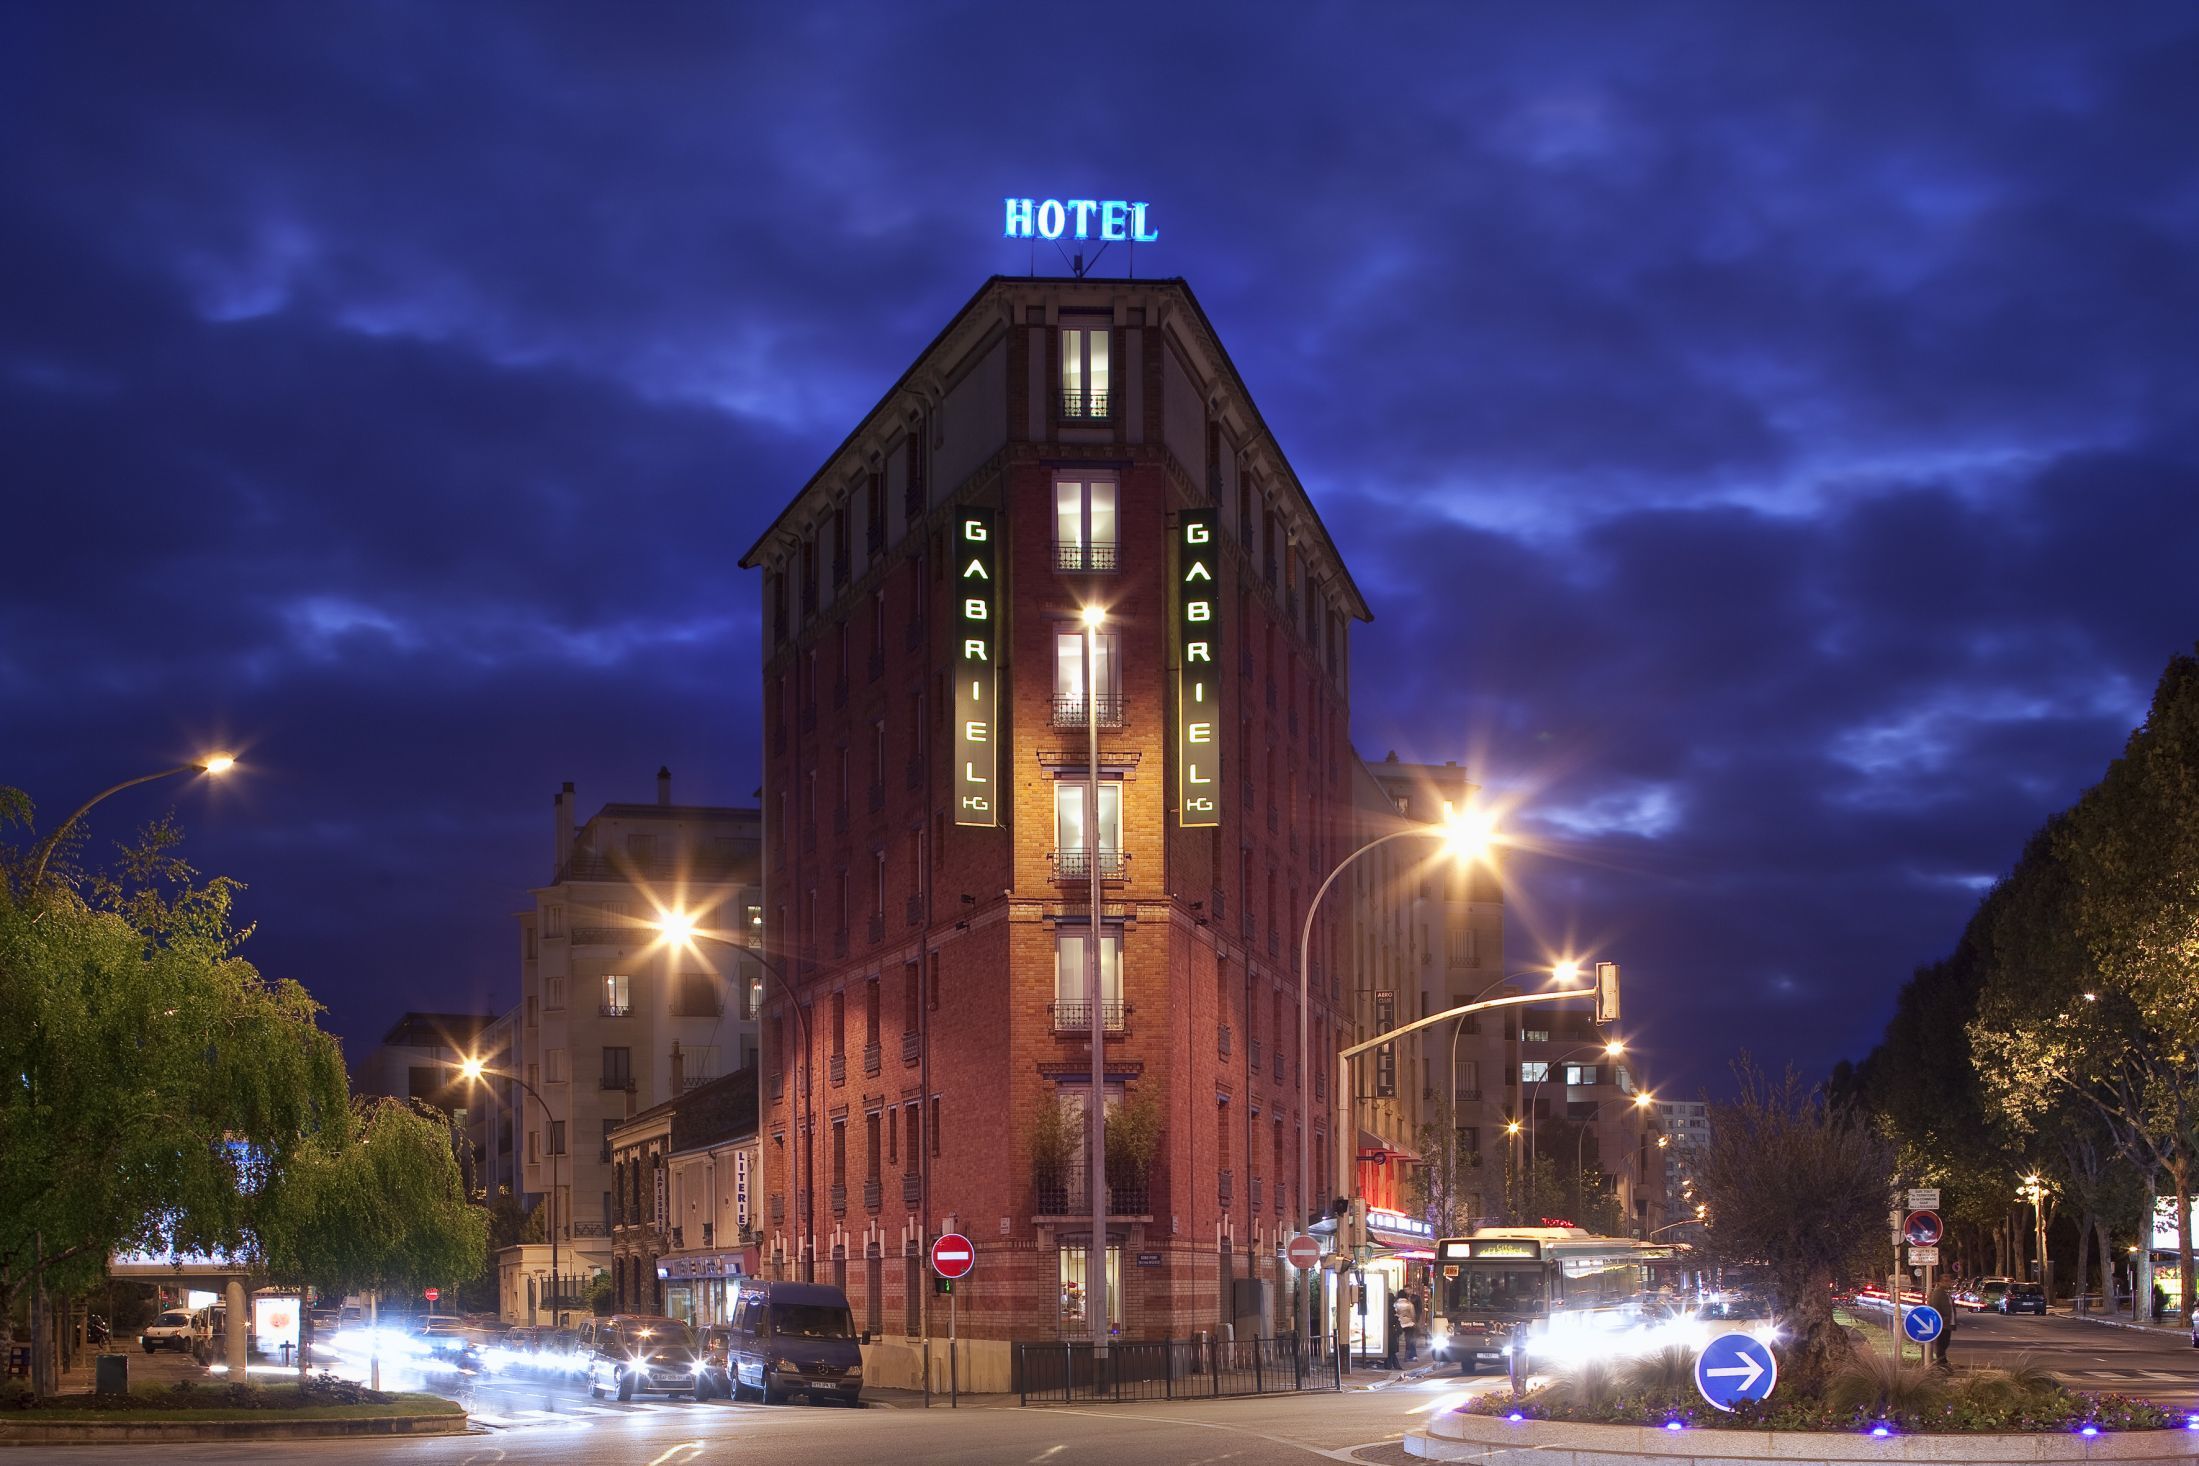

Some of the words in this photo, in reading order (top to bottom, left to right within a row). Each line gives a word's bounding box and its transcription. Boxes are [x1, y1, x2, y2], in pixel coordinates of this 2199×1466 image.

[1005, 198, 1159, 242] HOTEL
[963, 521, 989, 783] GABRIEL
[1185, 523, 1212, 784] GABRIEL
[656, 1169, 664, 1233] TAPISSERIE
[738, 1152, 746, 1223] LITERIE
